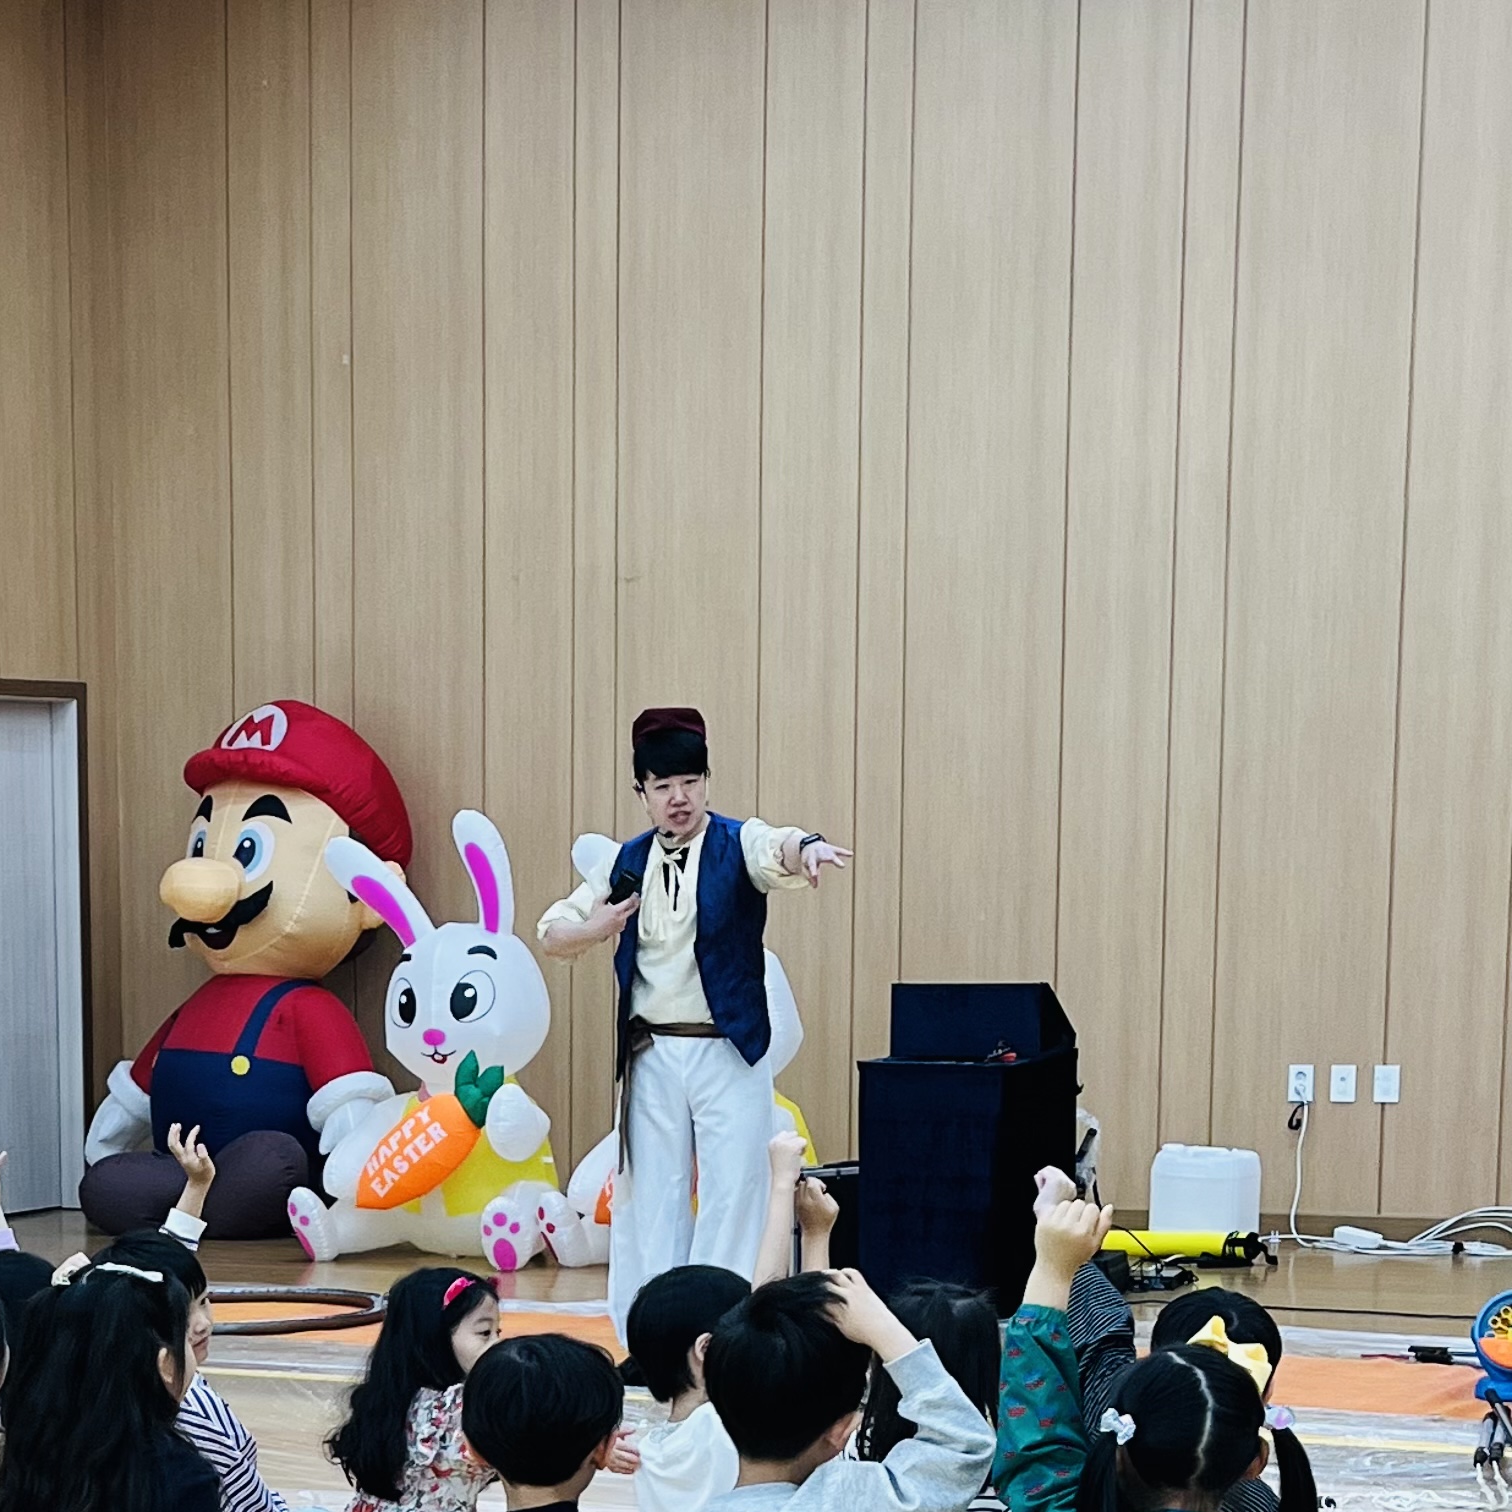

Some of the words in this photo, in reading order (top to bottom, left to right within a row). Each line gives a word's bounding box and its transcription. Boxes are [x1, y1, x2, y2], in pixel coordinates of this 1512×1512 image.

[226, 713, 275, 747] M
[366, 1105, 431, 1178] HAPPY
[370, 1121, 448, 1198] EASTER
